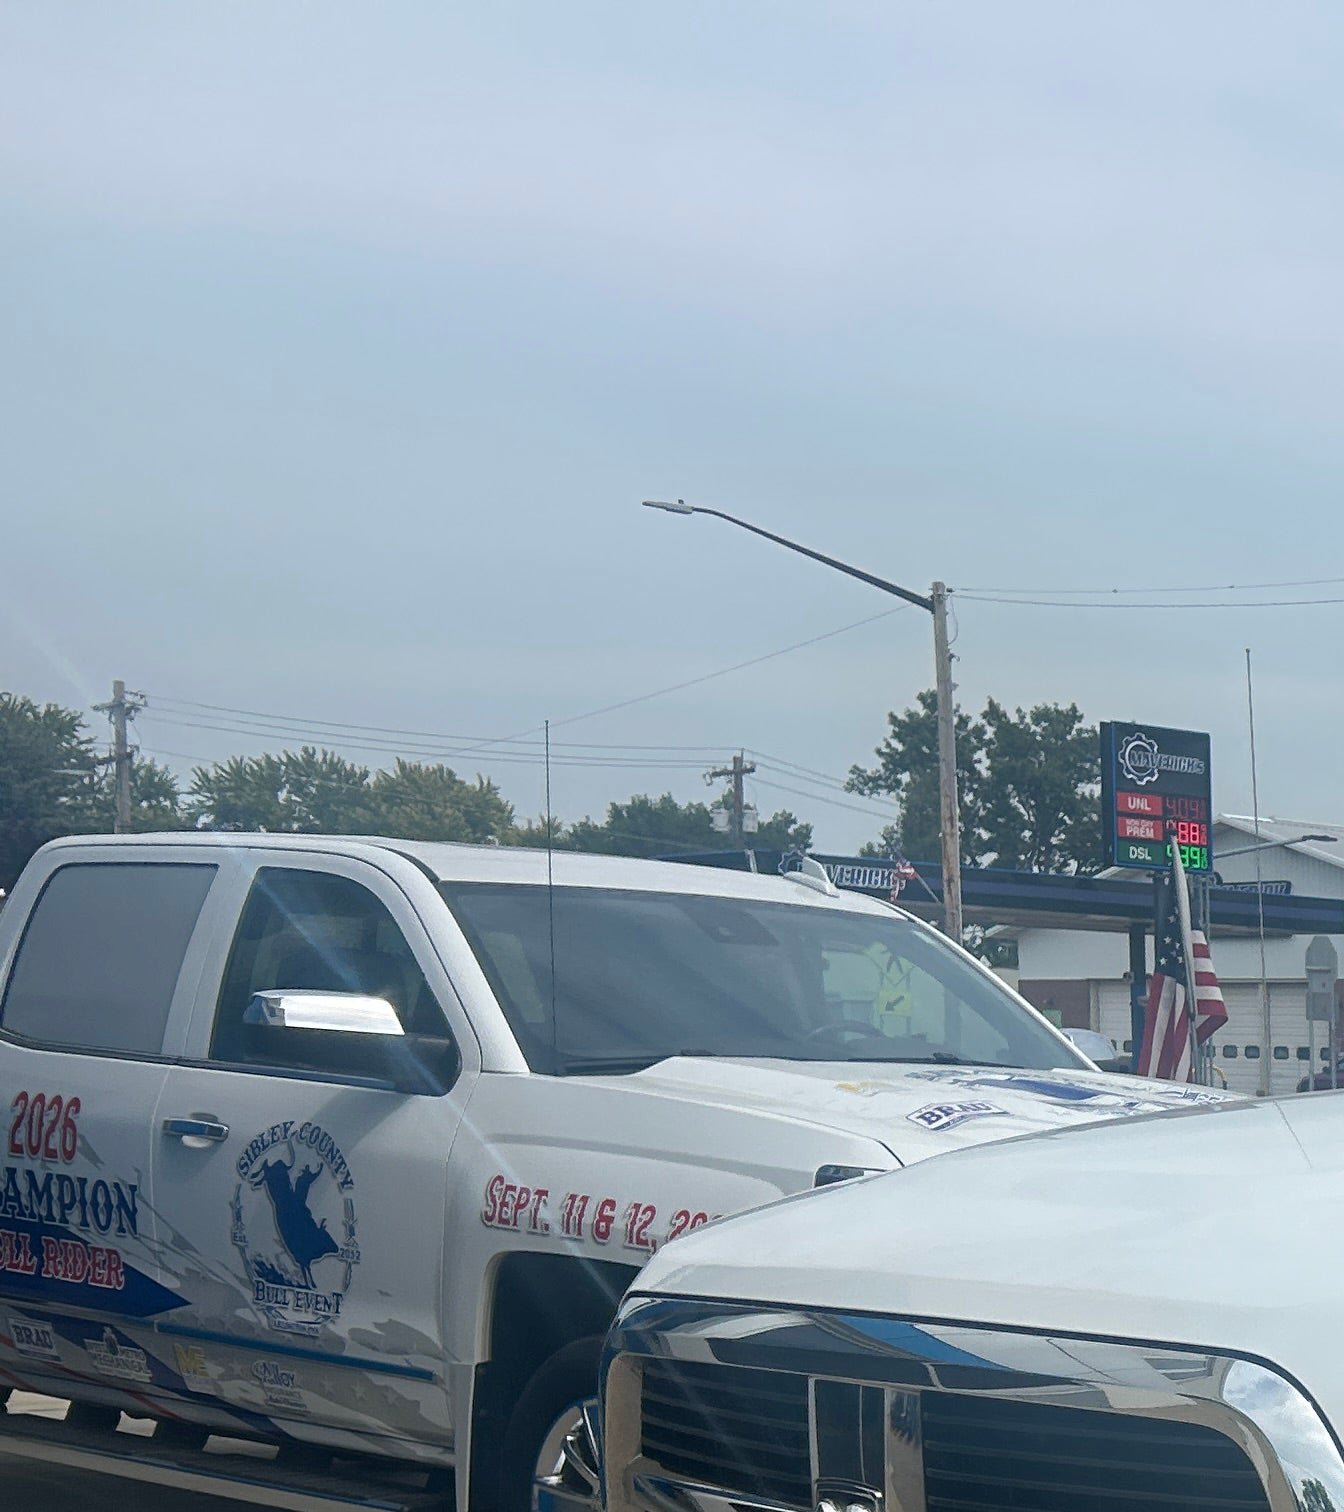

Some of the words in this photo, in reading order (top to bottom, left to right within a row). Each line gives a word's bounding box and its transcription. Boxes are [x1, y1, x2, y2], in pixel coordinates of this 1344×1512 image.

[1127, 797, 1152, 811] UNL
[1126, 825, 1155, 838] PREM
[1129, 846, 1152, 860] DSL
[9, 1090, 81, 1162] 2026
[915, 1102, 992, 1125] BRAU
[237, 1120, 297, 1177] SIBLEY
[300, 1121, 355, 1189] COUNTY
[0, 1167, 138, 1236] AMPION
[561, 1193, 590, 1238] 11
[593, 1198, 617, 1243] &
[41, 1236, 125, 1289] RIDER
[254, 1279, 290, 1306] BULL
[295, 1291, 344, 1315] EVENT
[11, 1324, 54, 1349] BRAU
